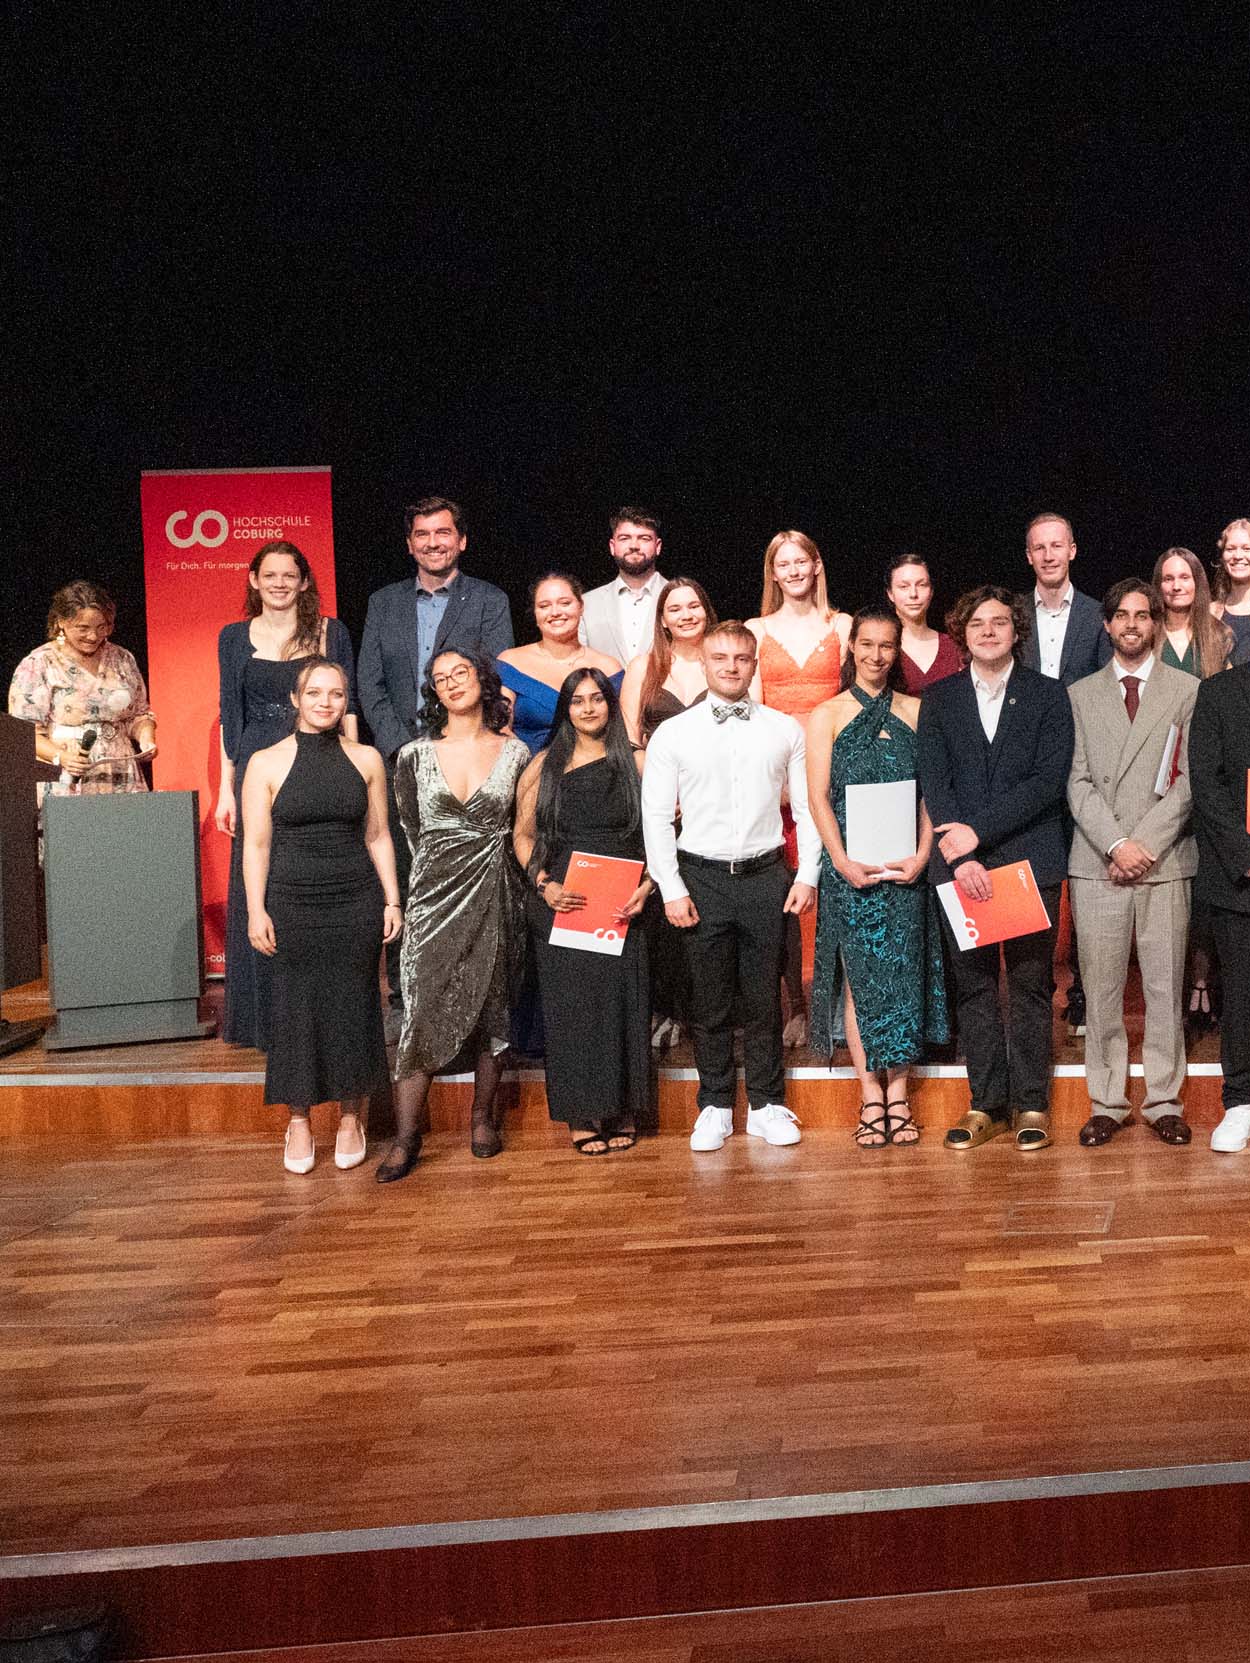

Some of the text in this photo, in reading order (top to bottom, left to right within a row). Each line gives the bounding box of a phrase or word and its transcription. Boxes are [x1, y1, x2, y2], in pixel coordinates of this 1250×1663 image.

[233, 515, 311, 527] HOCHSCHULE
[233, 528, 284, 539] COBURG
[166, 561, 179, 570] Für
[203, 561, 216, 569] Für
